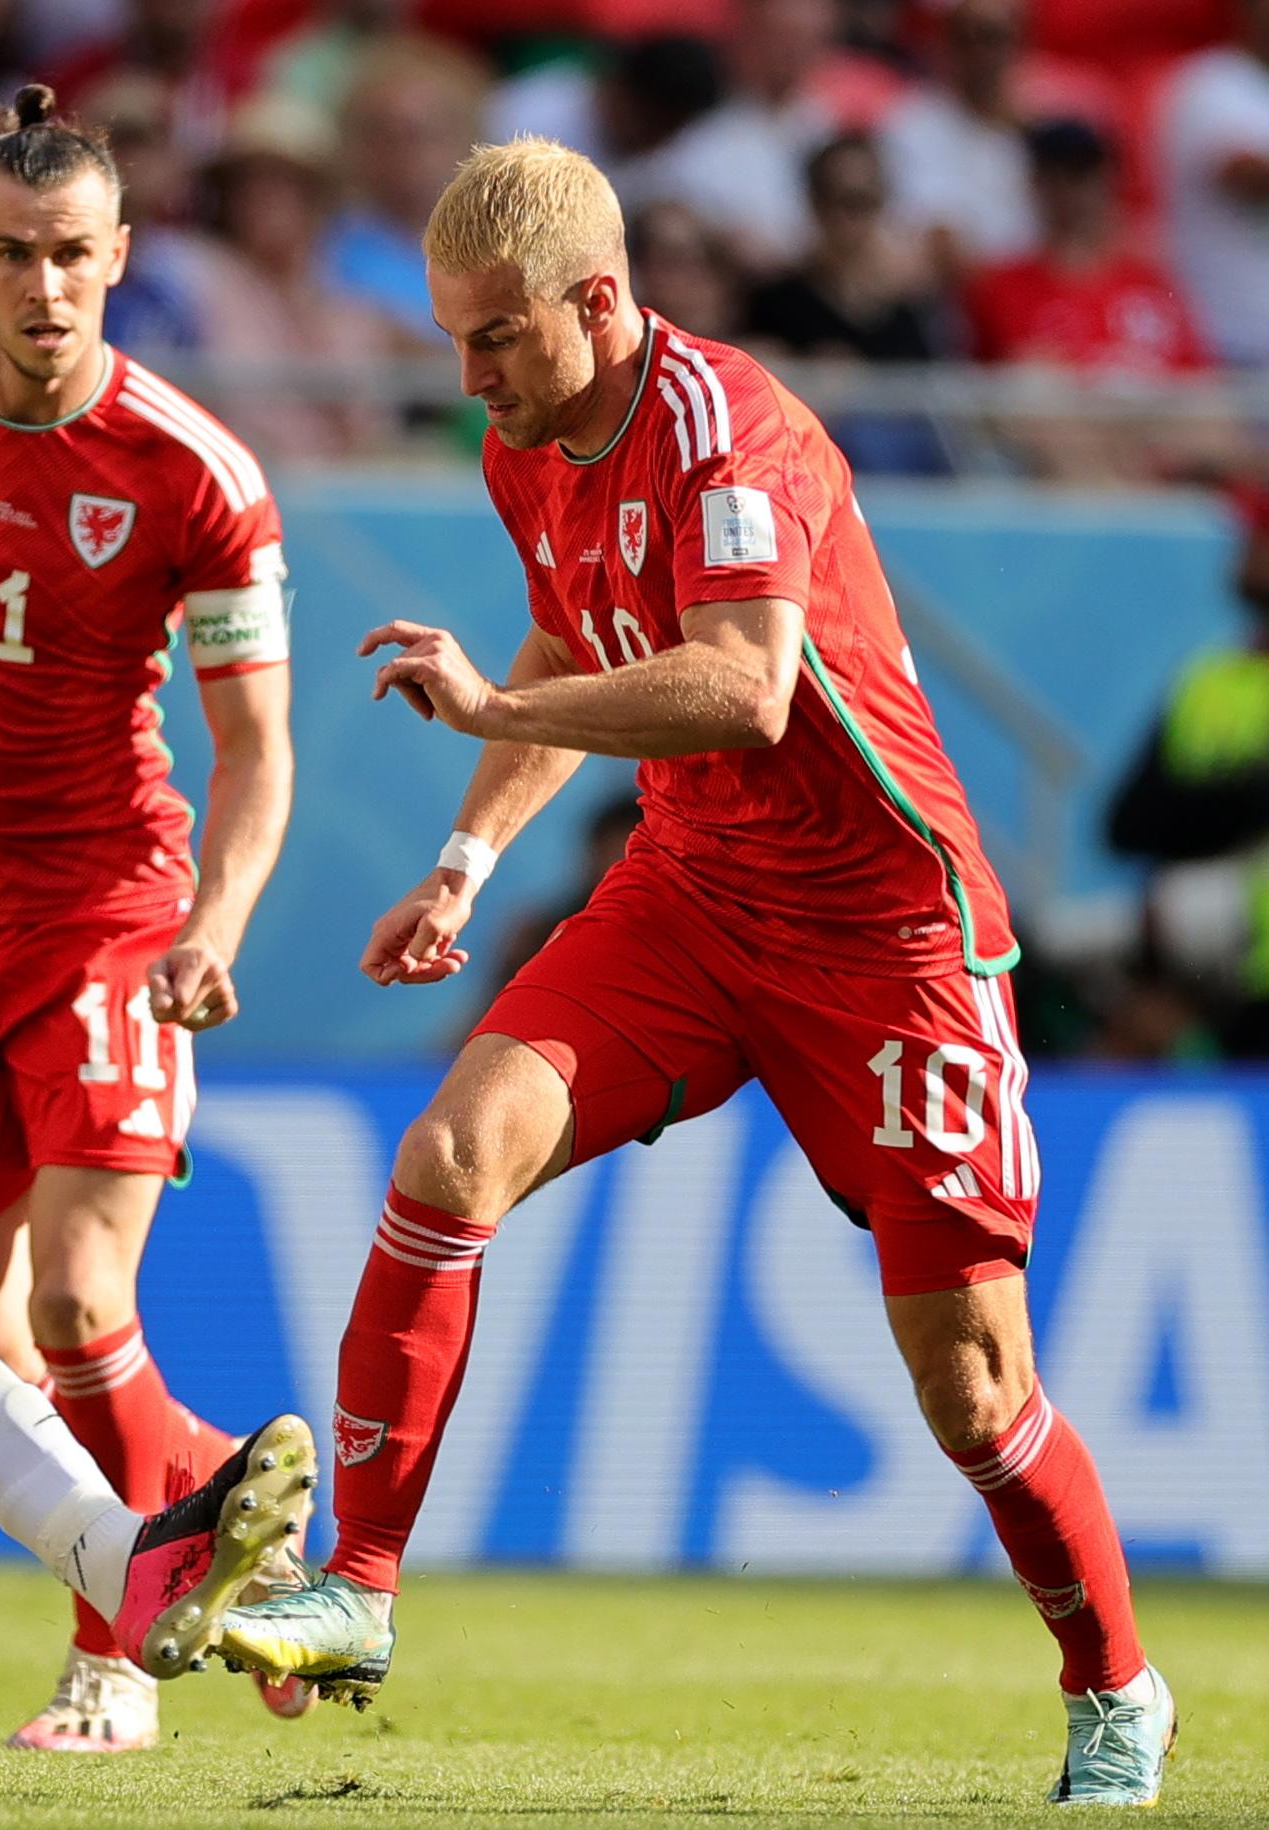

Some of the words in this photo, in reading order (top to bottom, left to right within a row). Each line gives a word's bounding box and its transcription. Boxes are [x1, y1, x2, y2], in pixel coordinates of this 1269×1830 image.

[580, 607, 653, 672] 10
[72, 982, 166, 1090] 11
[867, 1040, 986, 1152] 10
[192, 1090, 1269, 1576] VISA
